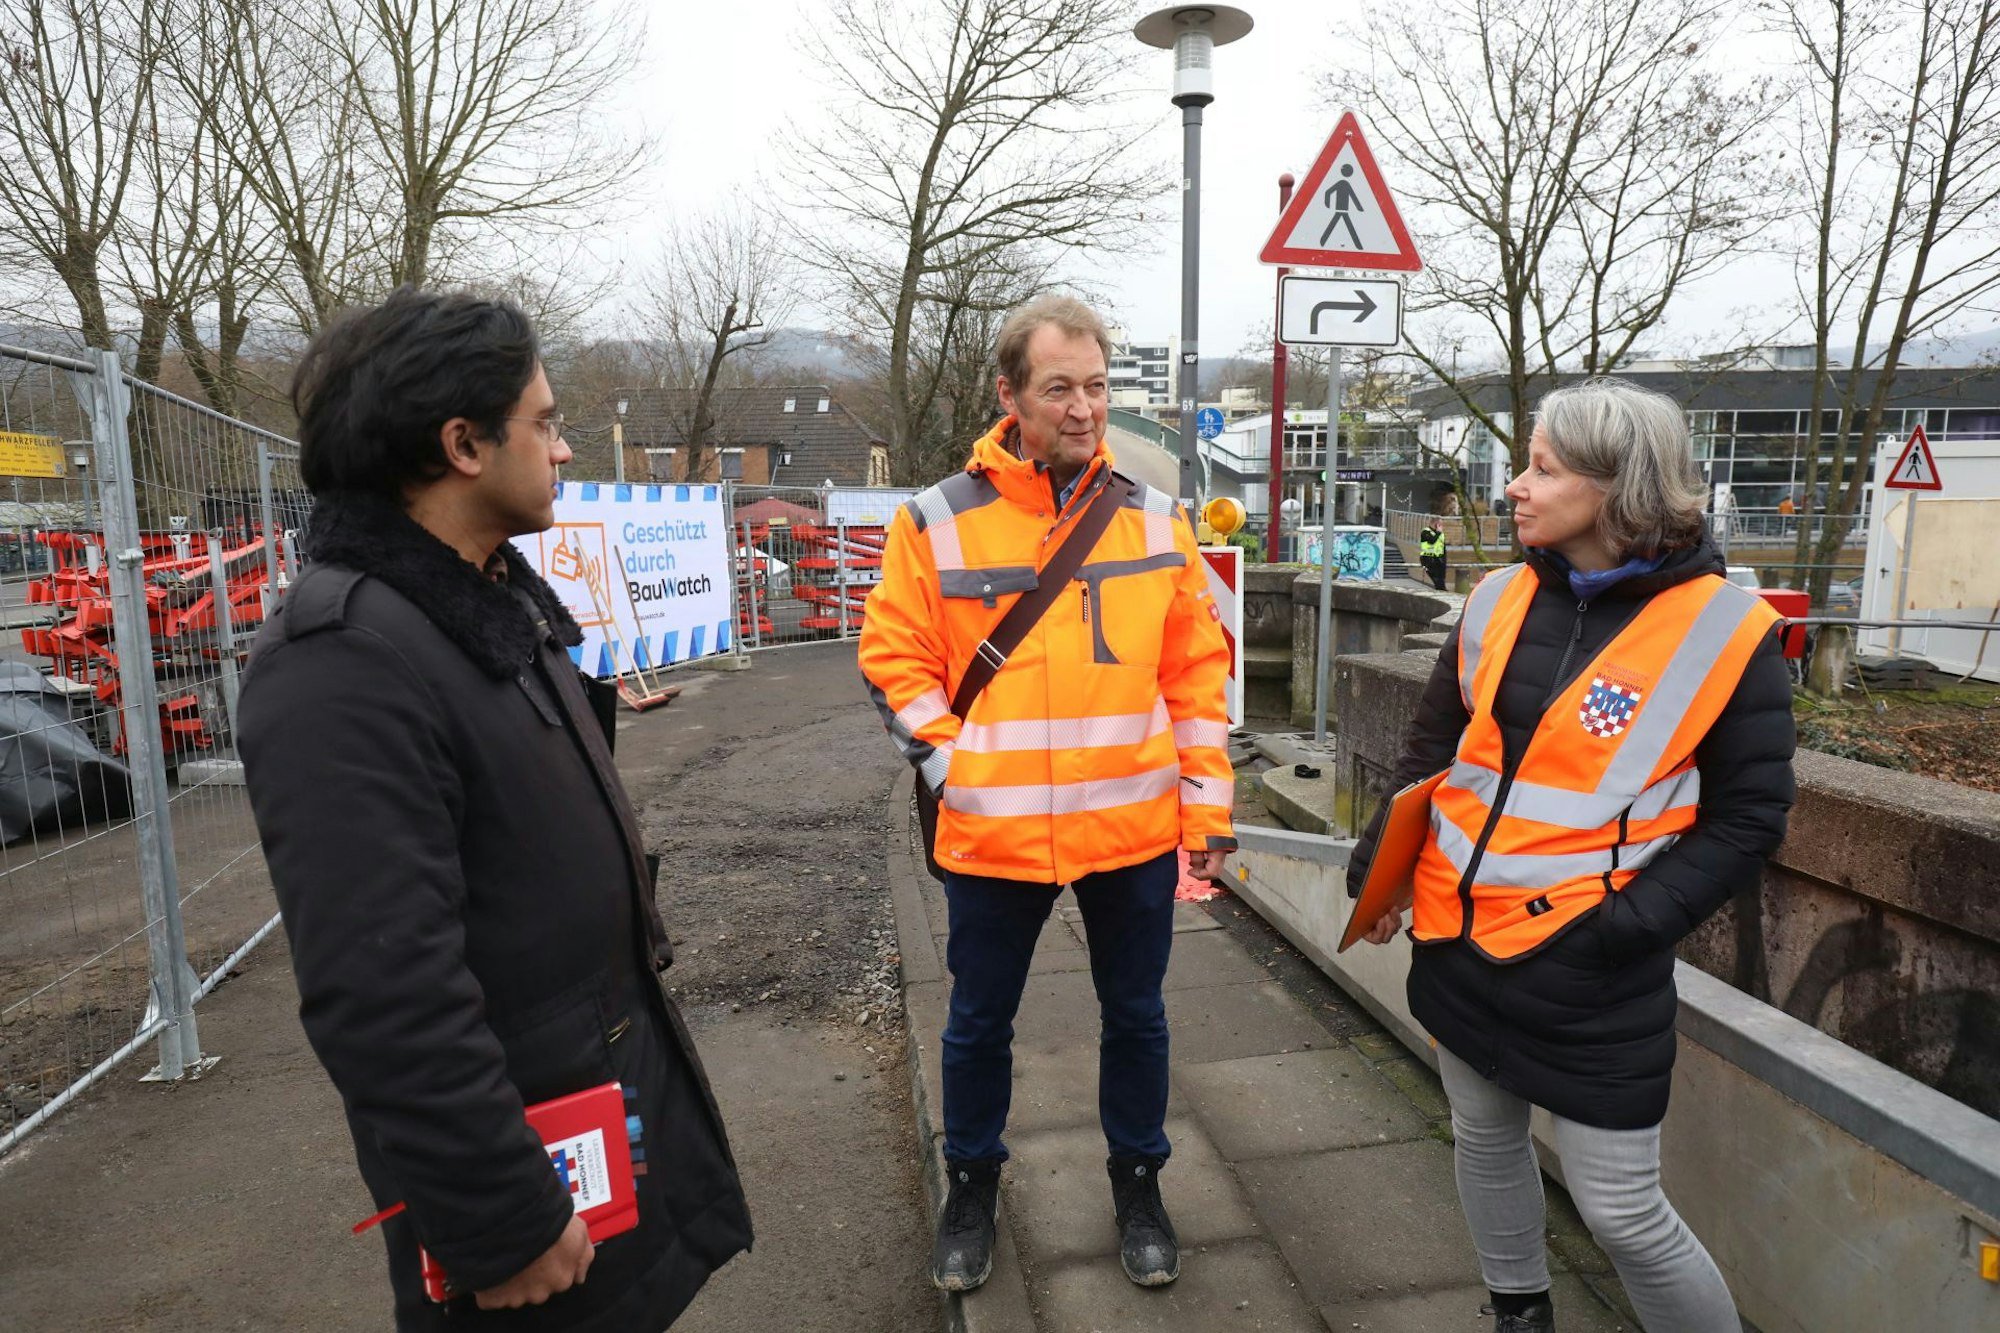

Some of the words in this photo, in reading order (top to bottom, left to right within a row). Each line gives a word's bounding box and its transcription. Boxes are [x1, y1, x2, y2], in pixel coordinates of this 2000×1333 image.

[623, 520, 707, 544] Geschützt
[626, 549, 676, 573] durch
[628, 574, 711, 603] BauWatch
[575, 1142, 585, 1162] BAD
[579, 1163, 590, 1201] HONNEF
